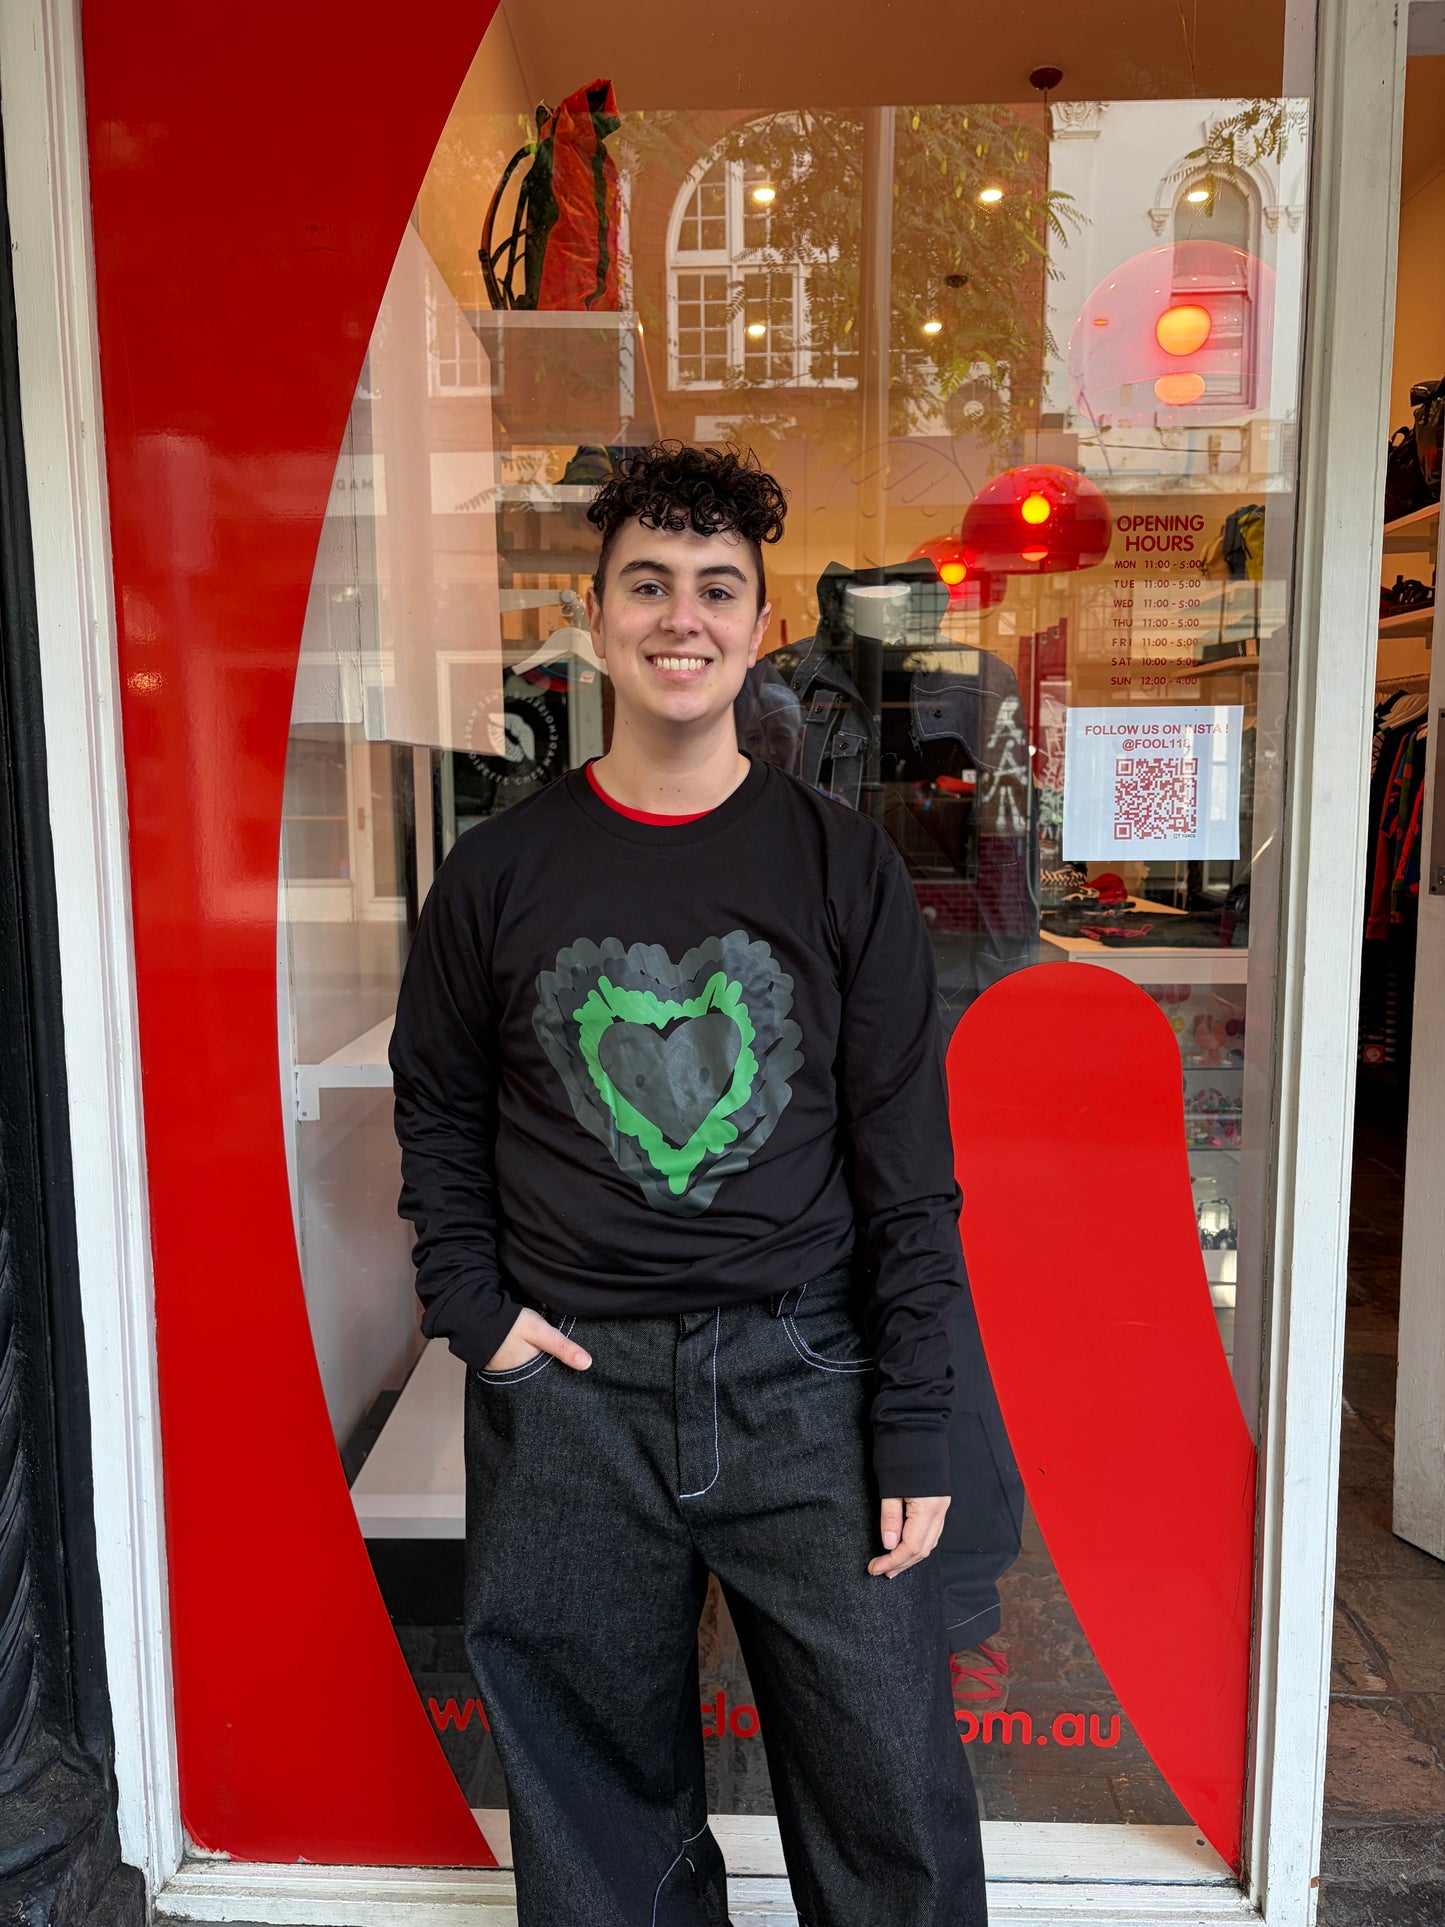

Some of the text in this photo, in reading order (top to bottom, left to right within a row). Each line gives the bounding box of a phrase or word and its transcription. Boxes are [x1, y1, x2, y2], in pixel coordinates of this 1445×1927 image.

[1116, 514, 1205, 532] OPENING
[1125, 534, 1195, 552] HOURS
[1114, 560, 1136, 569] MON
[1144, 560, 1170, 569] 11:00
[1179, 560, 1202, 569] 5:00
[1113, 579, 1135, 588] TUE
[1143, 579, 1169, 588] 11:00
[1178, 579, 1201, 589] 5:00
[1113, 599, 1134, 608] WED
[1143, 599, 1169, 608] 11:00
[1178, 599, 1200, 608] 5:00
[1113, 618, 1133, 627] THU
[1142, 618, 1168, 628] 11:00
[1177, 618, 1199, 628] 5:00
[1112, 638, 1132, 647] FRI
[1142, 638, 1168, 647] 11:00
[1176, 638, 1198, 647] 5:00
[1111, 657, 1132, 666] SAT
[1141, 657, 1167, 666] 10:00
[1110, 676, 1132, 685] SUN
[1140, 676, 1166, 685] 12:00
[1176, 676, 1198, 685] 4:00
[1085, 724, 1139, 735] FOLLOW
[1142, 724, 1159, 735] US
[1162, 724, 1181, 735] ON
[1184, 724, 1222, 734] INSTA
[955, 1710, 1121, 1748] om.au
